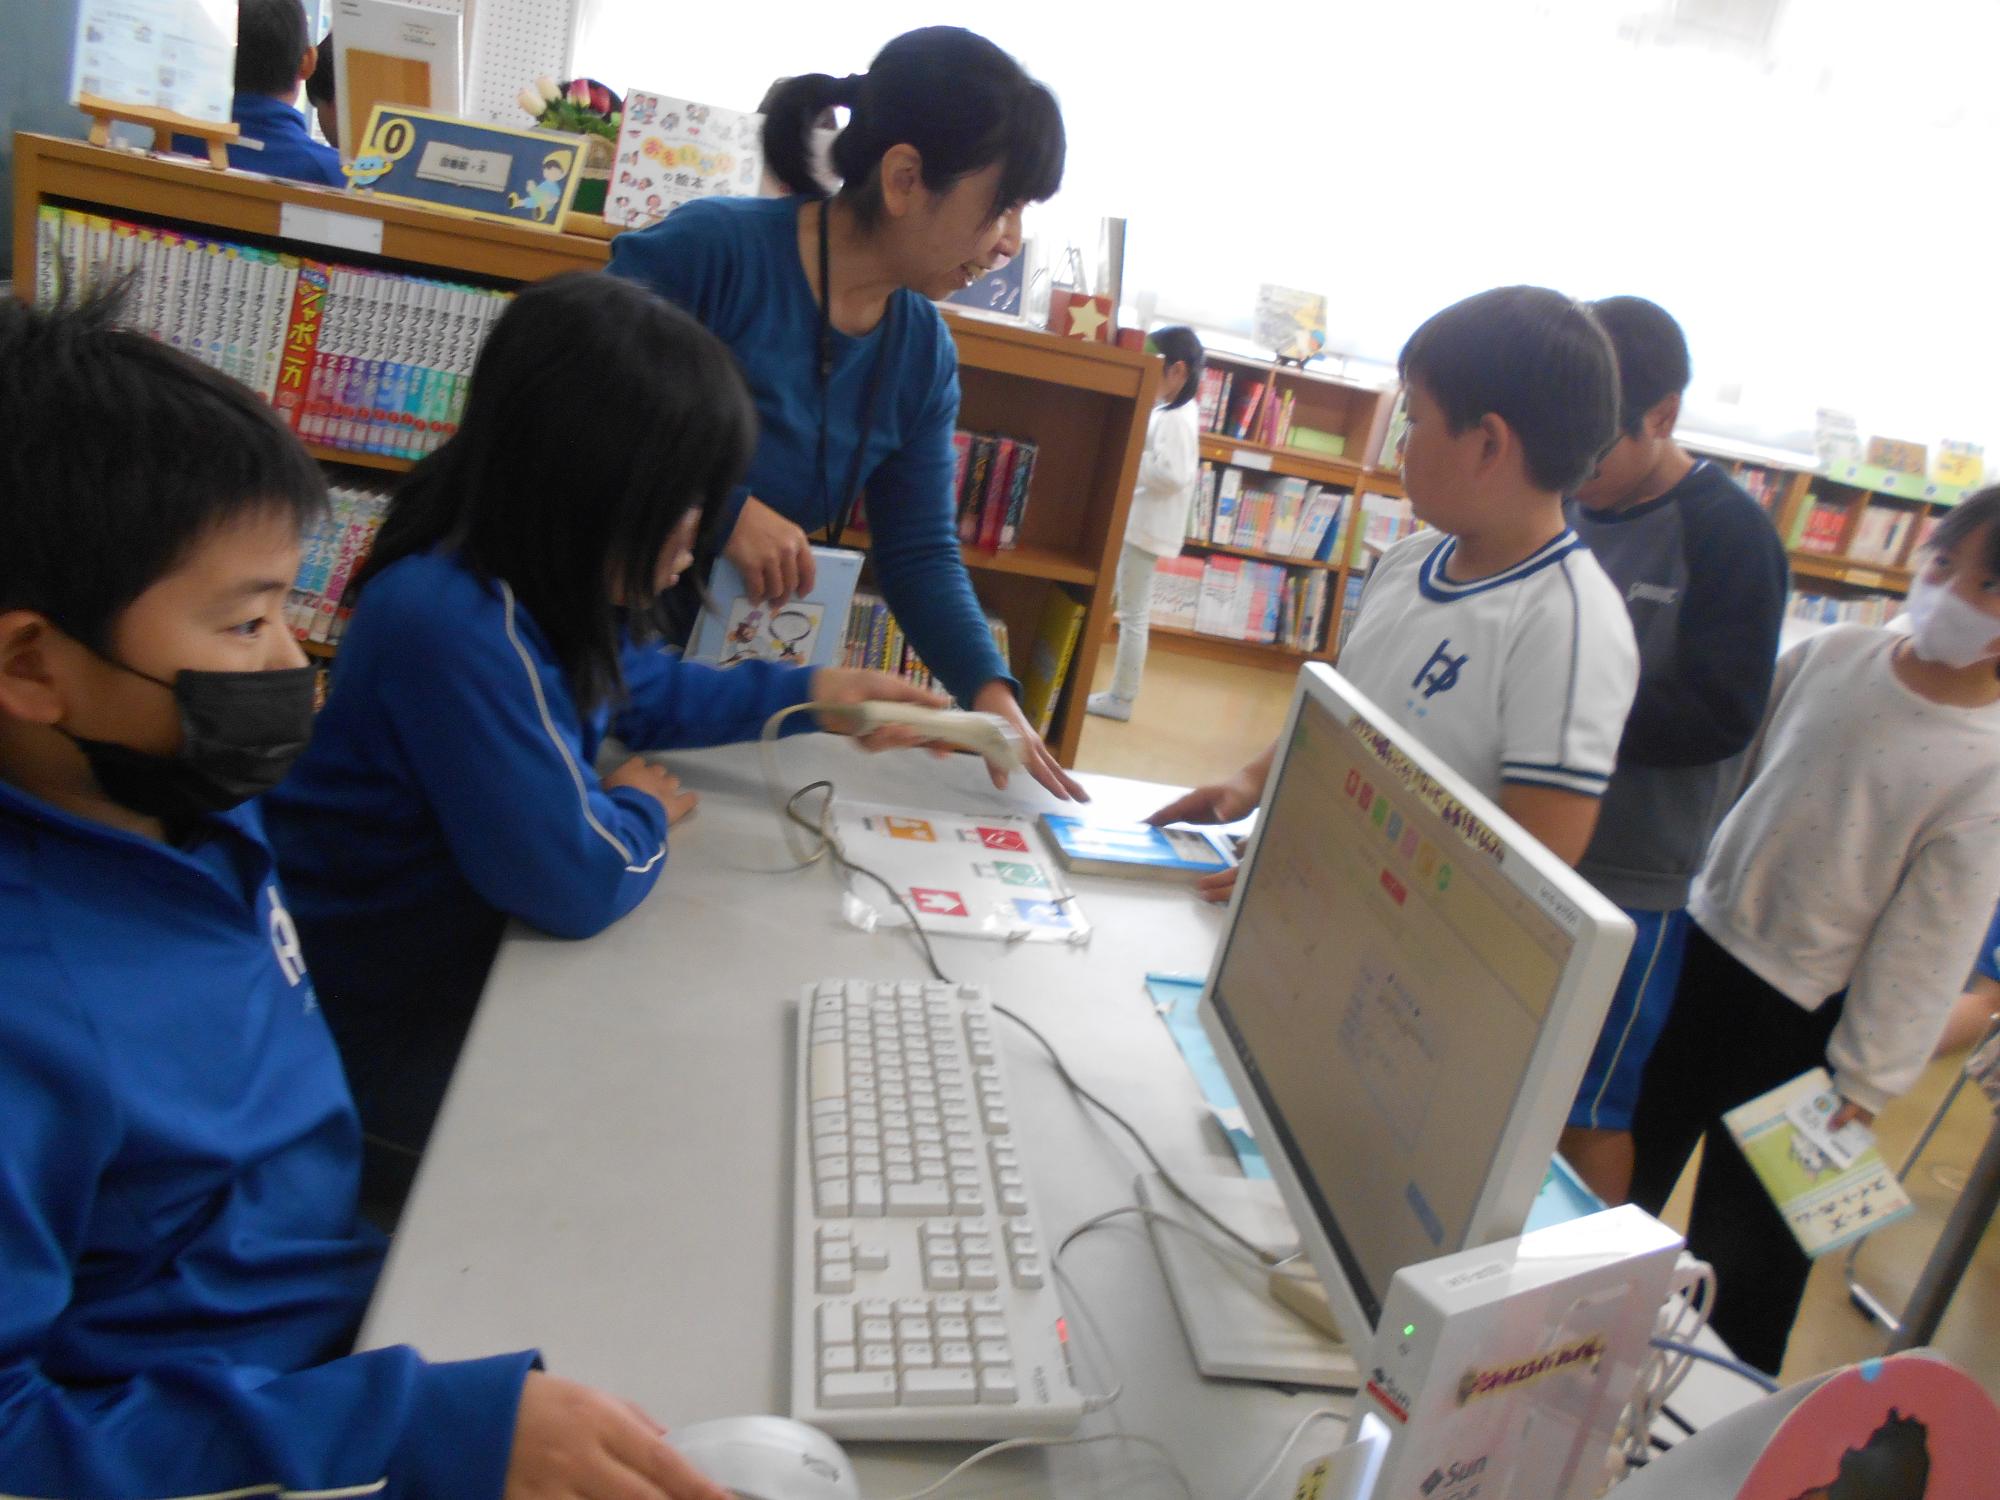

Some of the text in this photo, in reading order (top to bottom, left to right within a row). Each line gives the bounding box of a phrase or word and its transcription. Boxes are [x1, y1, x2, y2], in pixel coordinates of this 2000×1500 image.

[384, 123, 407, 154] 0
[282, 281, 326, 388] ジャポニカ
[327, 356, 338, 369] 2
